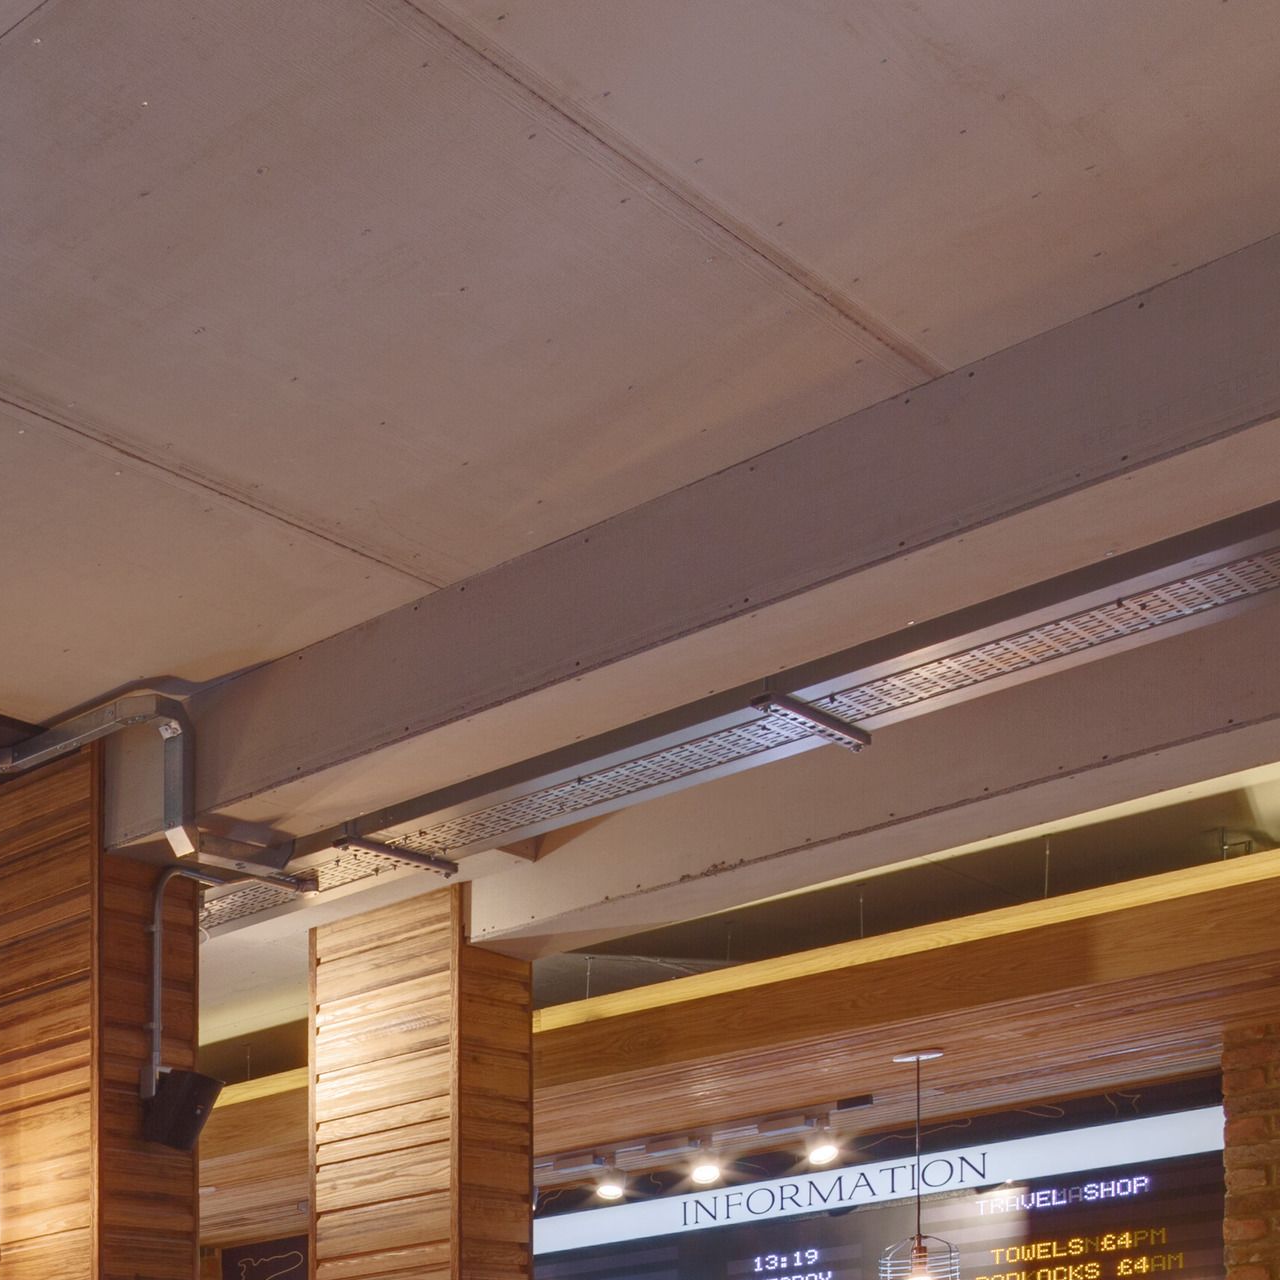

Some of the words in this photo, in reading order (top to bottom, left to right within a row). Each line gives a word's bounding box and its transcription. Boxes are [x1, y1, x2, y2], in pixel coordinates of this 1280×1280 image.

[682, 1152, 988, 1226] INFORMATION
[976, 1190, 1067, 1216] TRAVEL
[1084, 1176, 1150, 1202] SHOP
[754, 1250, 819, 1272] 13:19
[991, 1238, 1084, 1265] TOWELS
[1100, 1232, 1133, 1252] £4
[1117, 1256, 1149, 1276] £4
